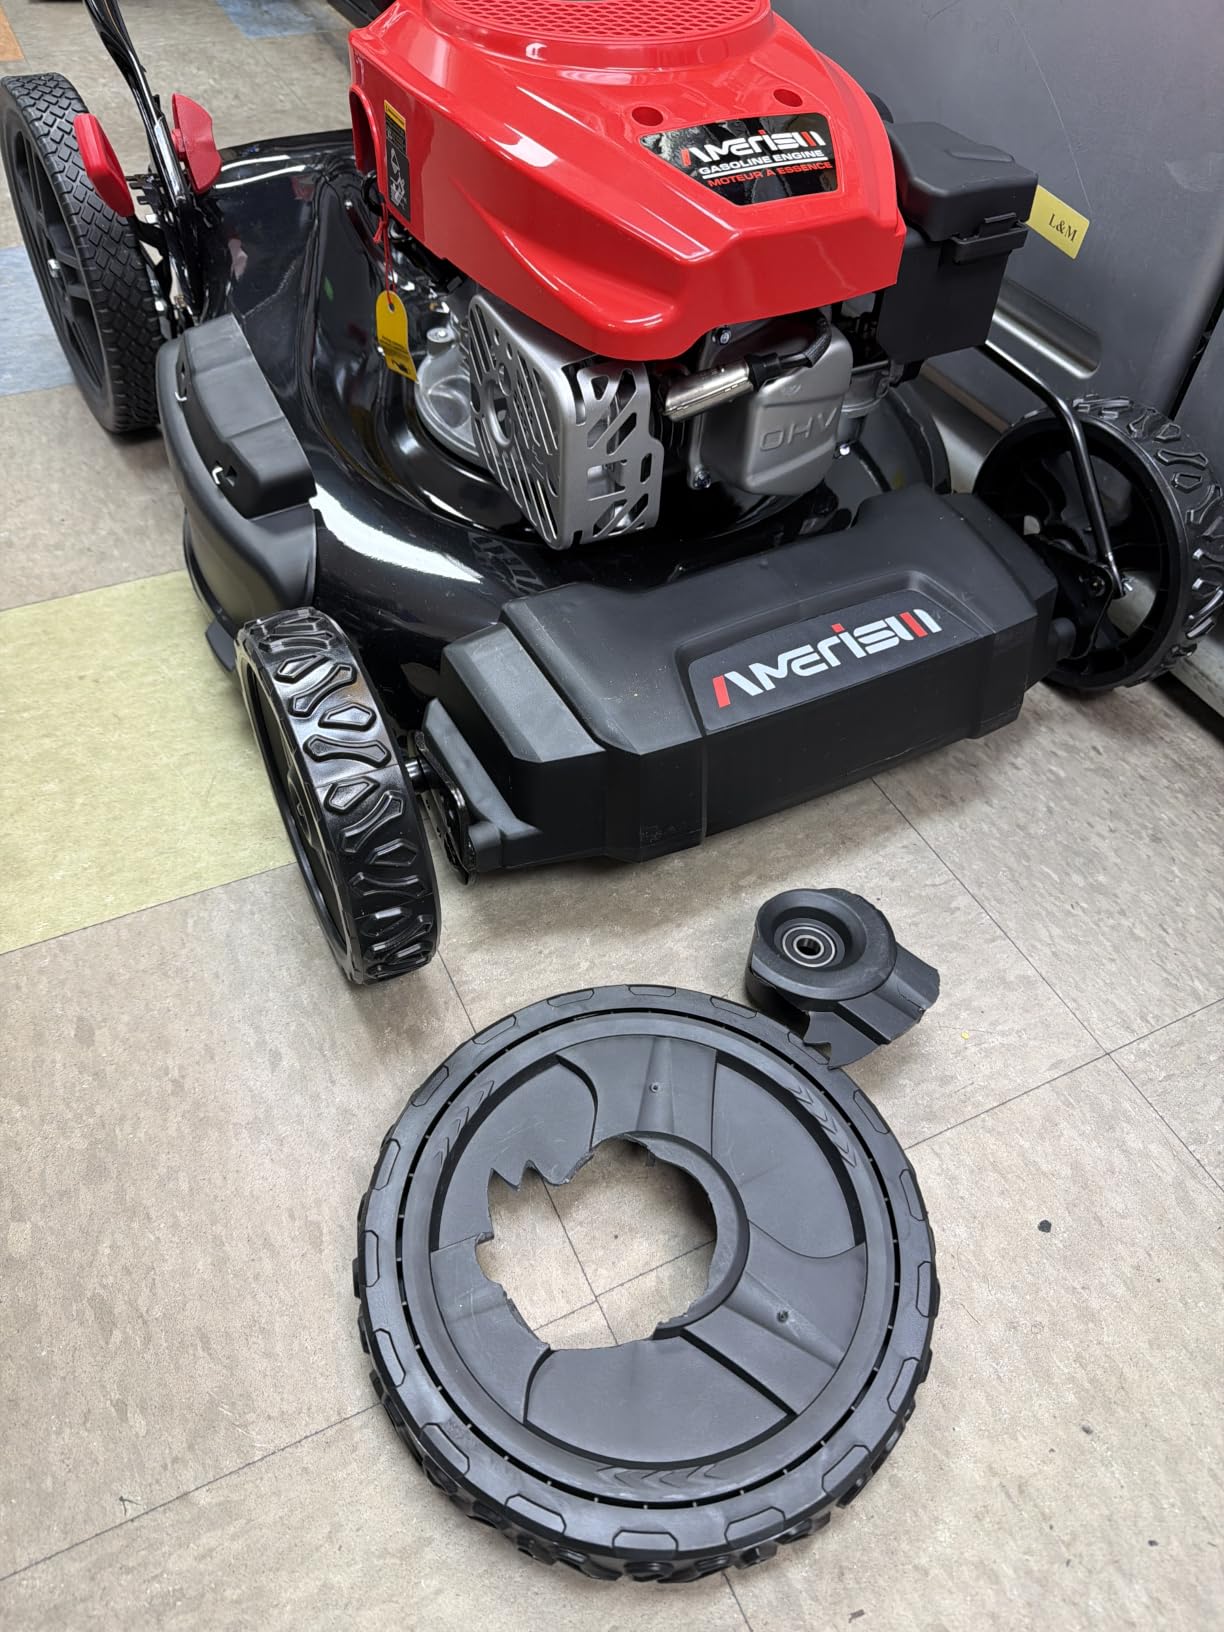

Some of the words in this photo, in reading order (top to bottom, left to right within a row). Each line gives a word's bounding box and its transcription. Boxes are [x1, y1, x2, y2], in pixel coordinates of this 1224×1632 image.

[699, 156, 772, 174] GASOLINE
[773, 150, 824, 161] ENGINE
[707, 171, 763, 187] MOTEUR
[776, 162, 832, 174] ESSENCE
[1049, 213, 1077, 242] L&M
[760, 407, 837, 452] OHV
